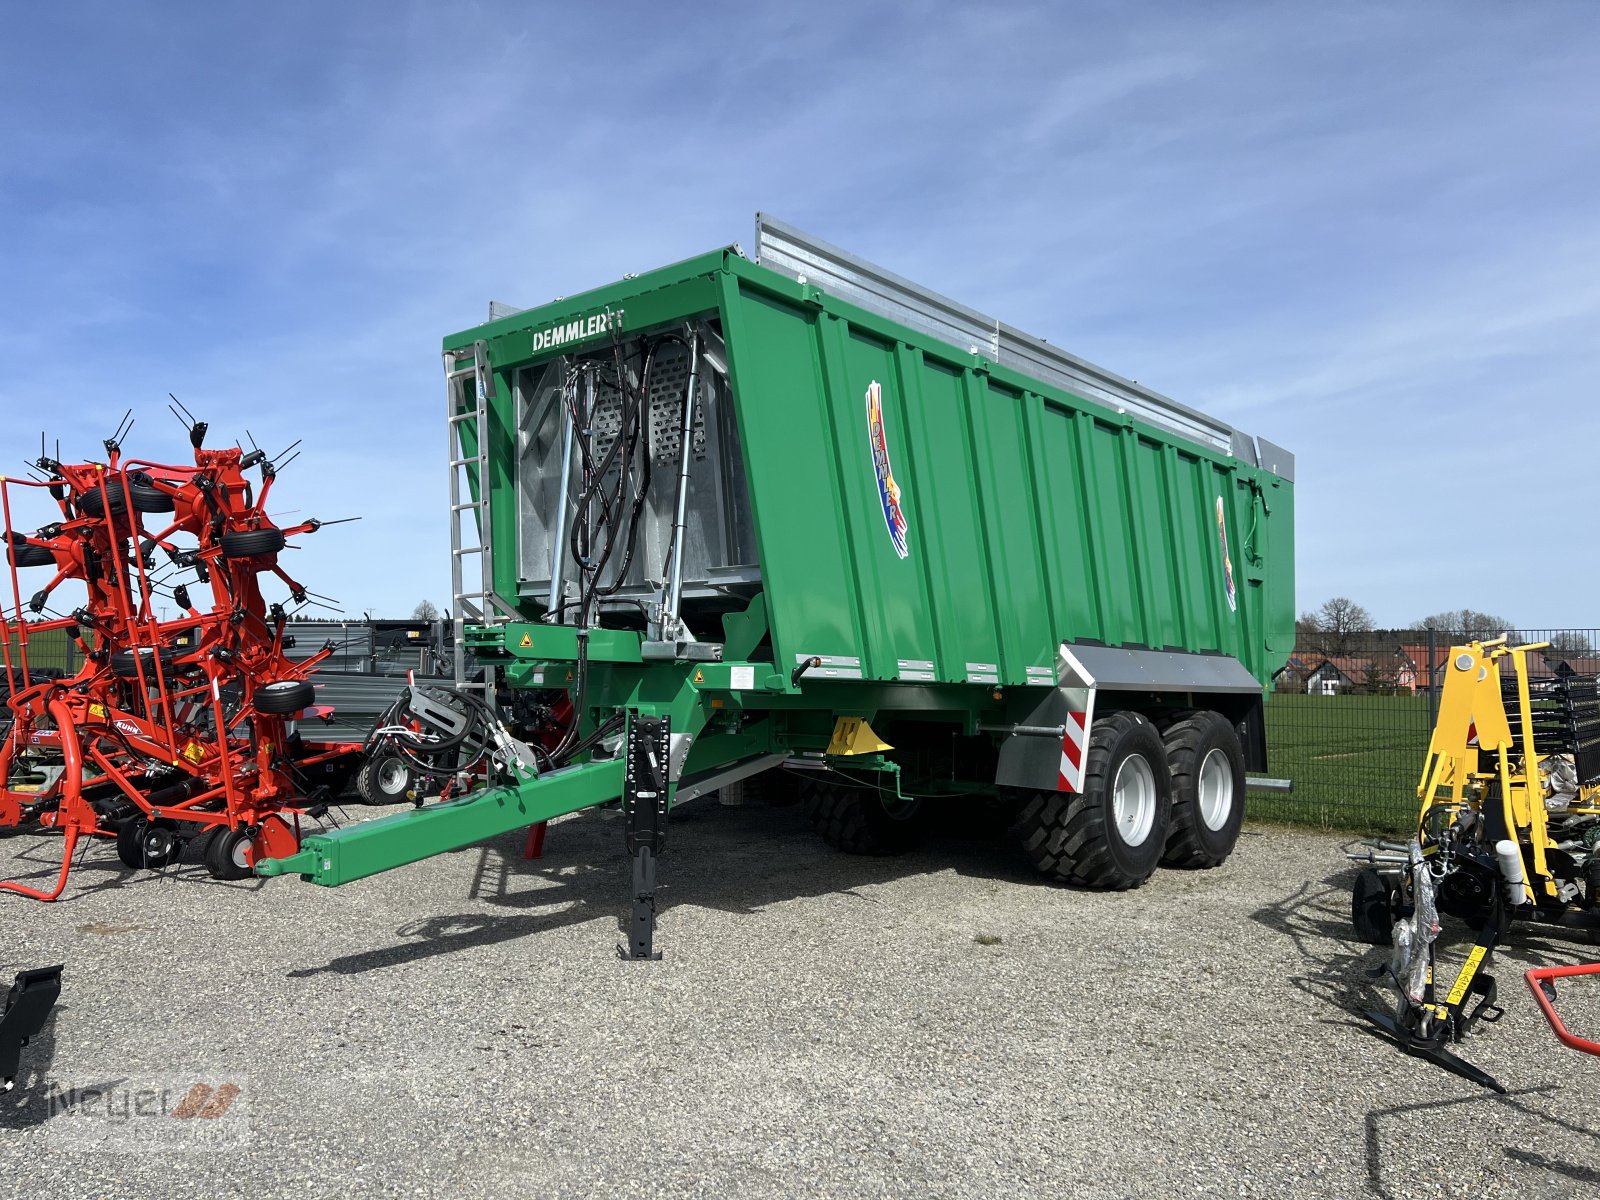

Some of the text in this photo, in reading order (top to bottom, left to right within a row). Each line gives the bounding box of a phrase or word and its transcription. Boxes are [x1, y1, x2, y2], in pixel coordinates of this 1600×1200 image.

[533, 313, 607, 351] DEMMLER
[873, 421, 897, 520] DEMMLER
[116, 721, 139, 734] KUHN
